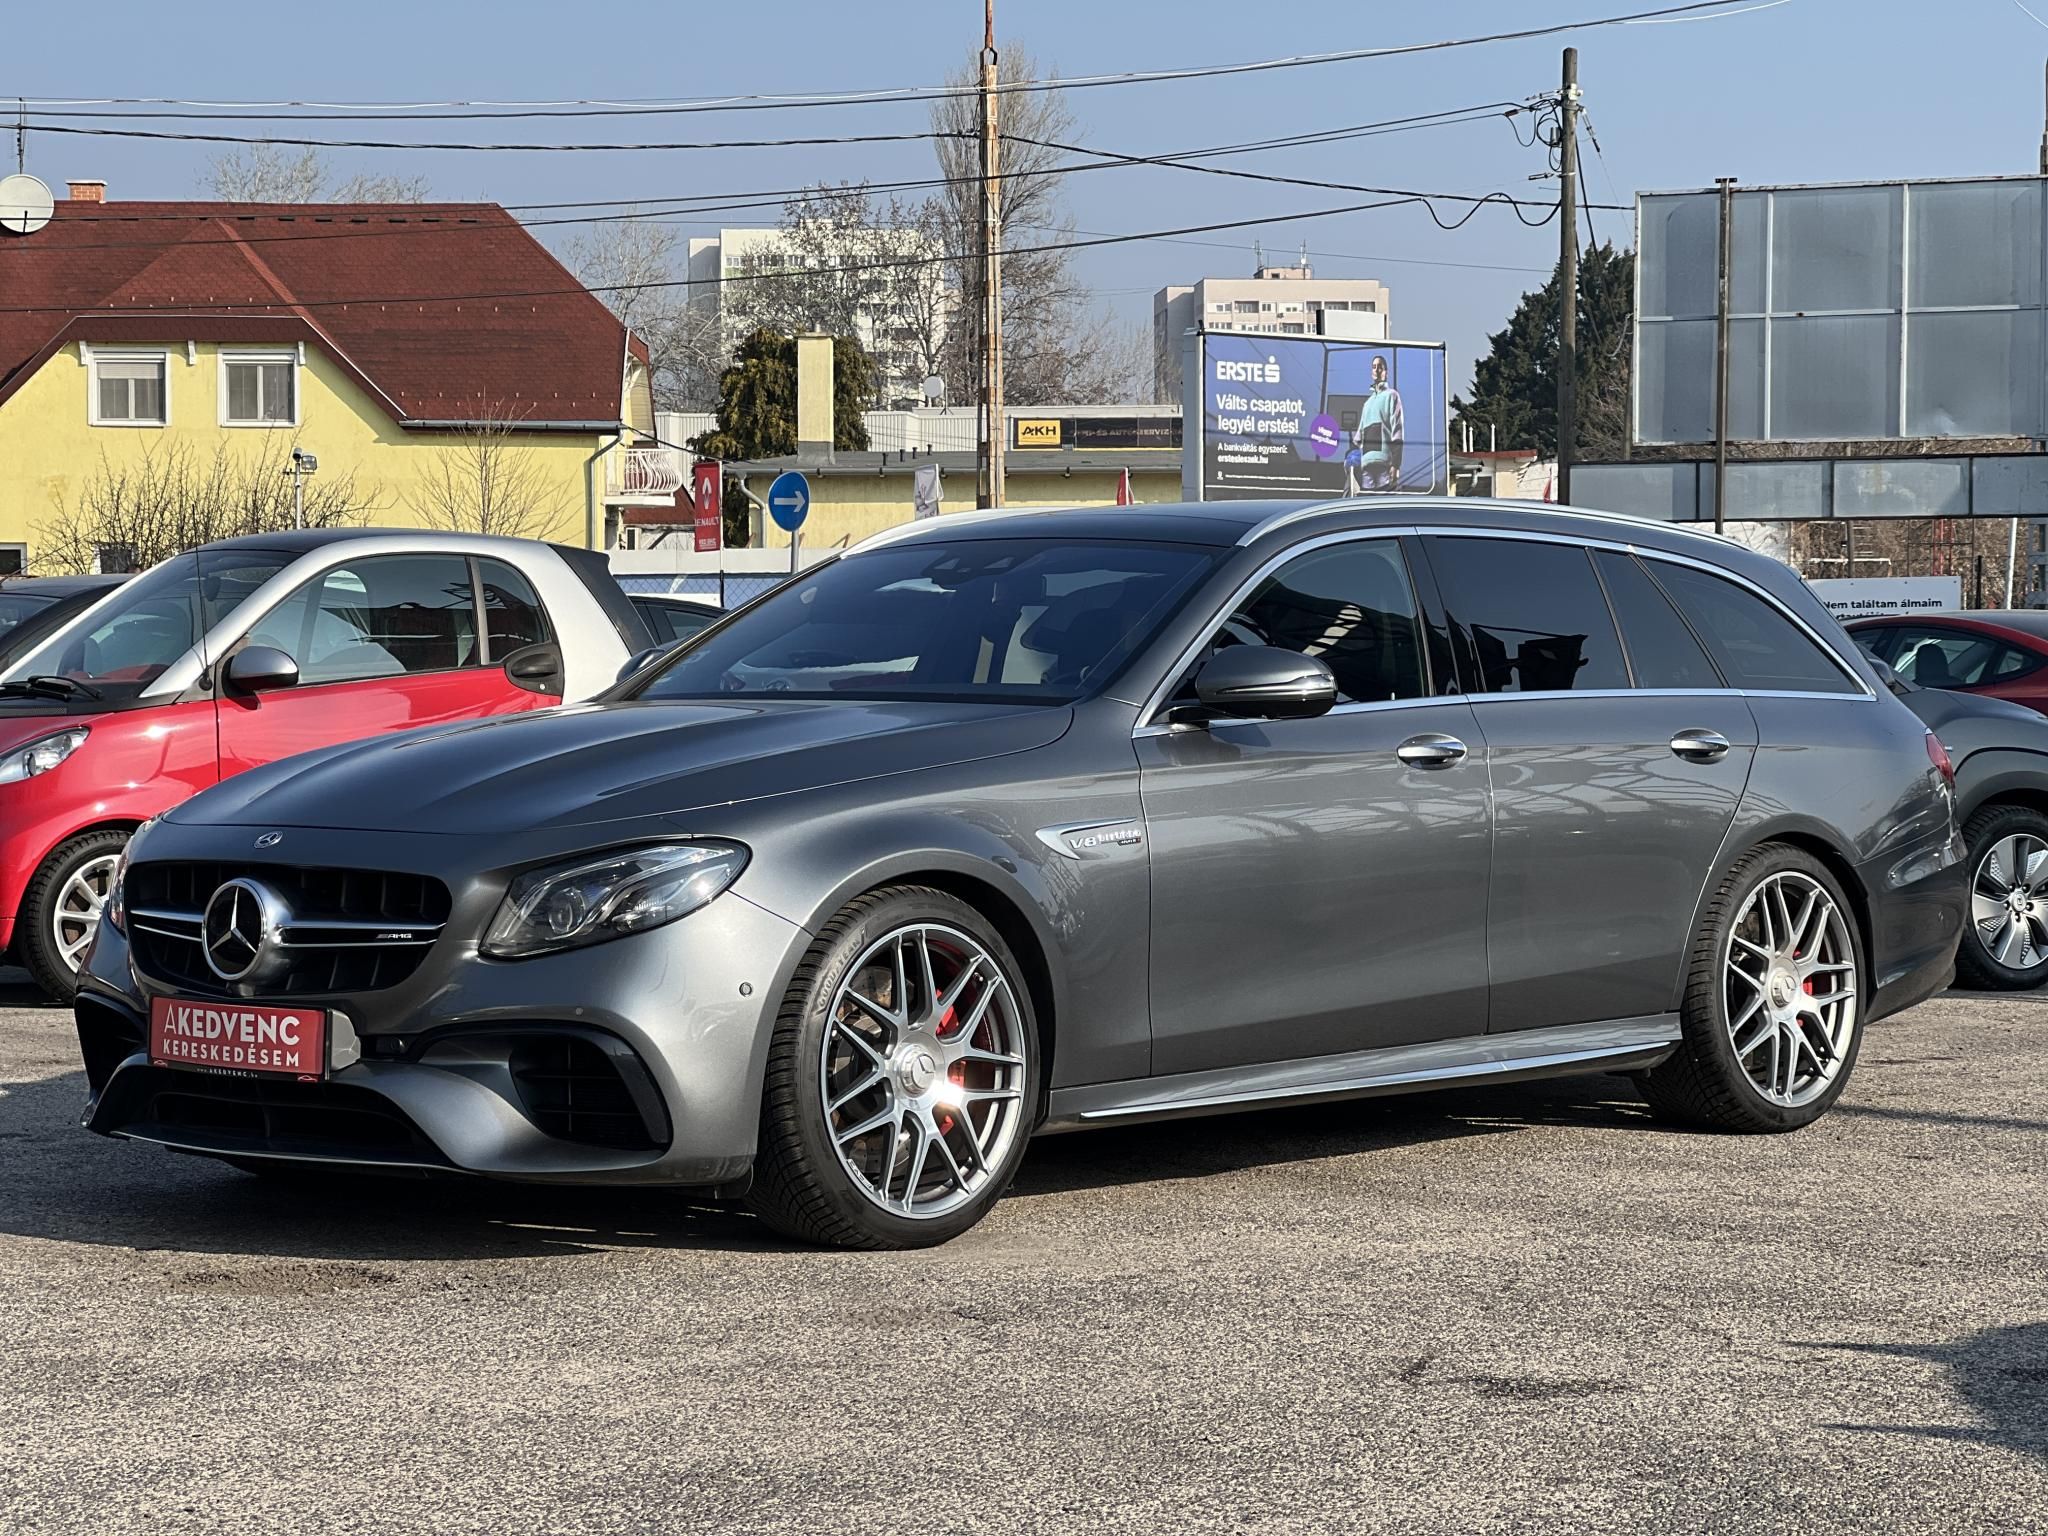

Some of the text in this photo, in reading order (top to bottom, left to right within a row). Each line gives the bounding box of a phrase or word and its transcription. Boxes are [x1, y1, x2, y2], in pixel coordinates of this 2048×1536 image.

[1217, 361, 1263, 382] ERSTE
[1216, 394, 1306, 417] Válts csapatot,
[1021, 425, 1056, 436] AKH
[1218, 415, 1255, 434] legyél
[1257, 417, 1299, 434] erstés!
[1217, 442, 1223, 451] A
[1851, 599, 1898, 609] találtam
[1900, 598, 1943, 608] álmaim
[1069, 836, 1097, 849] V8
[163, 1039, 299, 1067] KERESKEDÉSEM
